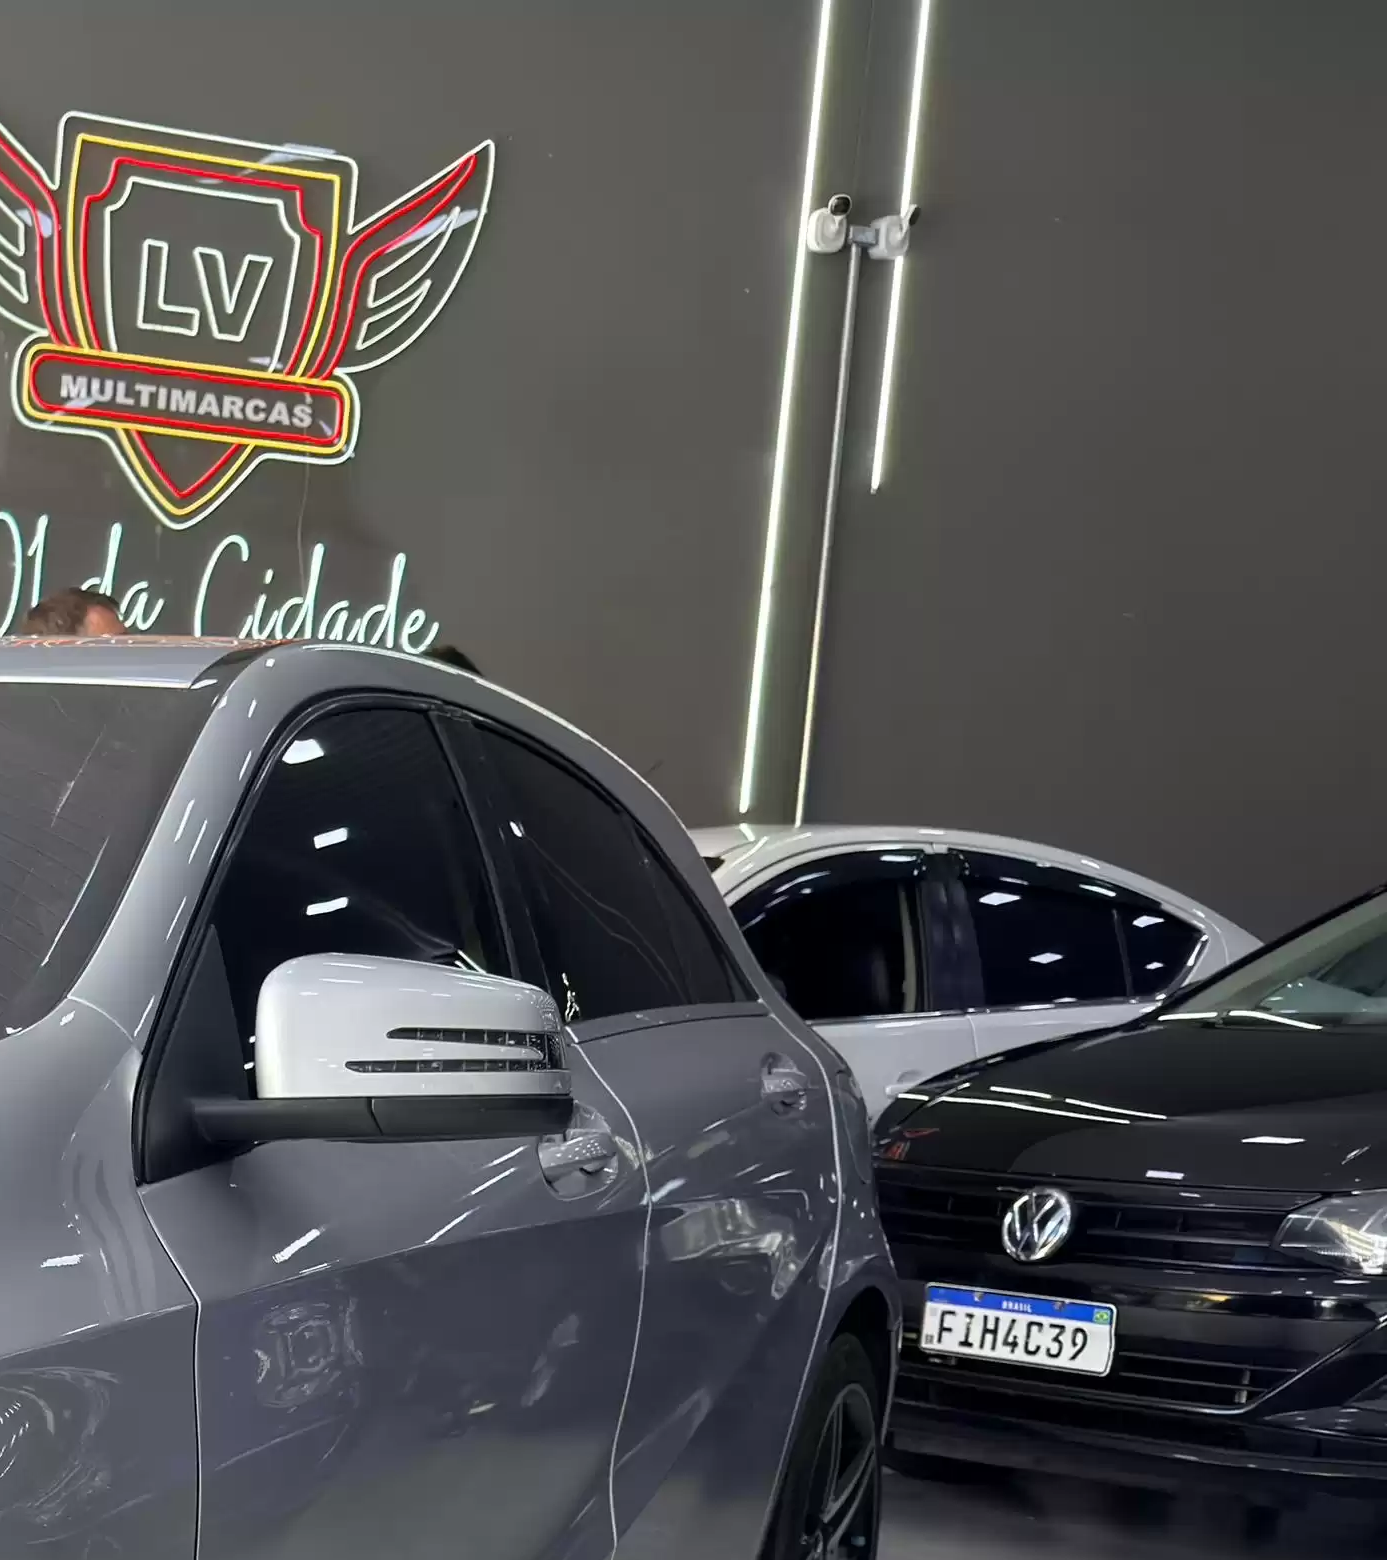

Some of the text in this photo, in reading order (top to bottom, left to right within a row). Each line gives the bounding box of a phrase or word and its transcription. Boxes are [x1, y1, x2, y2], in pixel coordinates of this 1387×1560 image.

[136, 238, 274, 342] LV
[59, 373, 314, 428] MULTIMARCAS
[193, 534, 439, 654] Cidade
[937, 1310, 1088, 1361] FIH4C39
